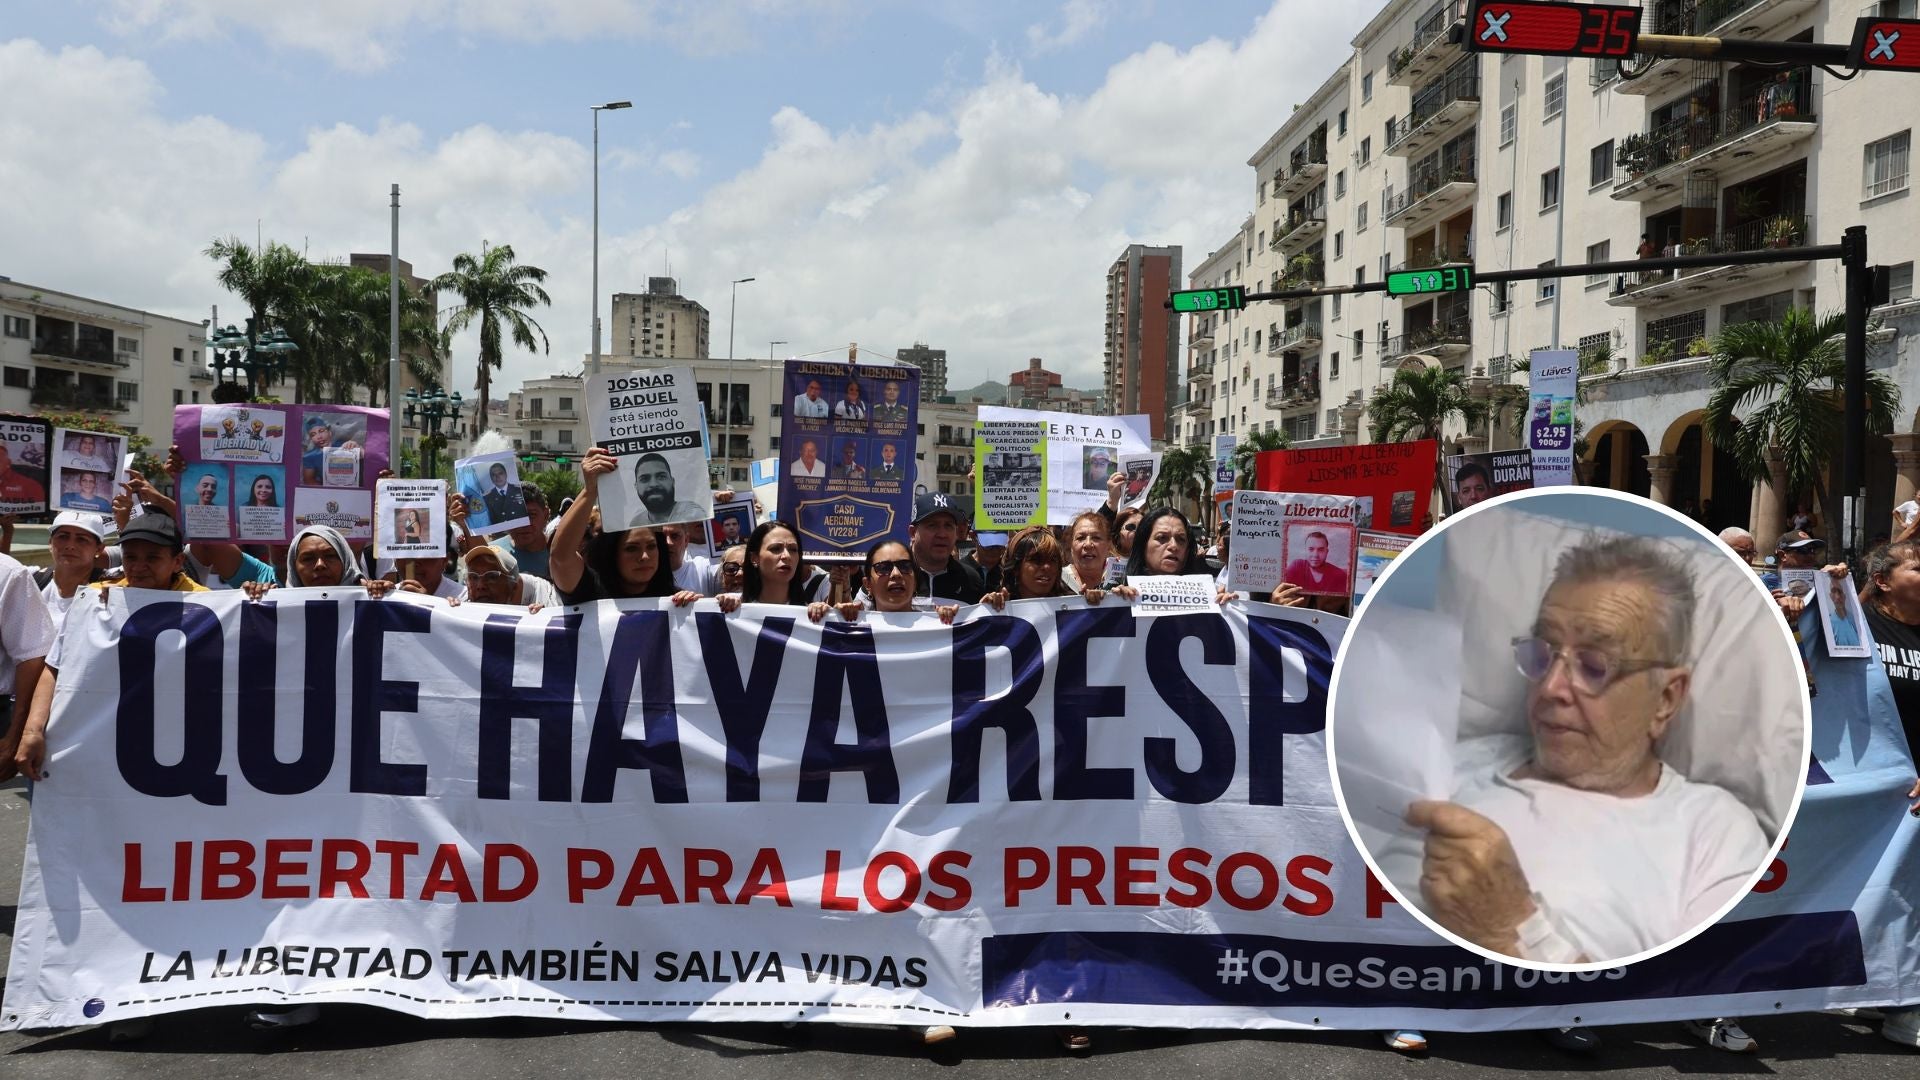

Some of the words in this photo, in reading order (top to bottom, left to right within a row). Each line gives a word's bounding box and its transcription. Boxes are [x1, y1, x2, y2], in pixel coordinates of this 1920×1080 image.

[1581, 9, 1635, 55] 35
[1445, 268, 1471, 290] 31
[1218, 289, 1241, 309] 31
[798, 362, 844, 376] JUSTICIA
[848, 366, 854, 377] Y
[860, 366, 908, 380] LIBERTAD
[1541, 366, 1572, 376] Llaves
[608, 374, 675, 392] JOSNAR
[610, 391, 678, 409] BADUEL
[610, 412, 634, 424] está
[638, 408, 678, 420] siendo
[10, 424, 46, 434] más
[610, 418, 684, 436] torturado
[1536, 427, 1566, 438] $2.95
[213, 437, 258, 450] LIBERTAD
[258, 440, 271, 453] YA
[608, 442, 626, 454] EN
[628, 442, 644, 452] EL
[646, 436, 692, 450] RODEO
[1086, 438, 1122, 446] Maracaibo
[1286, 448, 1344, 465] JUSTICIA
[1348, 446, 1356, 460] Y
[1359, 443, 1415, 460] LIBERTAD
[1493, 454, 1530, 467] FRANKLIN
[1494, 464, 1531, 483] DURÁN
[934, 494, 948, 508] NY
[834, 505, 855, 516] CASO
[1284, 503, 1354, 522] Libertad!
[823, 516, 864, 526] AERONAVE
[1238, 517, 1280, 527] Ramírez
[828, 528, 858, 538] YV2284
[1890, 664, 1910, 678] HAY
[116, 600, 435, 806] QUE
[477, 609, 900, 804] HAYA
[121, 838, 539, 903] LIBERTAD
[566, 847, 793, 908] PARA
[820, 849, 973, 914] LOS
[1003, 845, 1335, 917] PRESOS
[139, 950, 195, 984] LA
[210, 945, 432, 981] LIBERTAD
[442, 941, 639, 984] TAMBIÉN
[653, 950, 786, 984] SALVA
[800, 952, 928, 988] VIDAS
